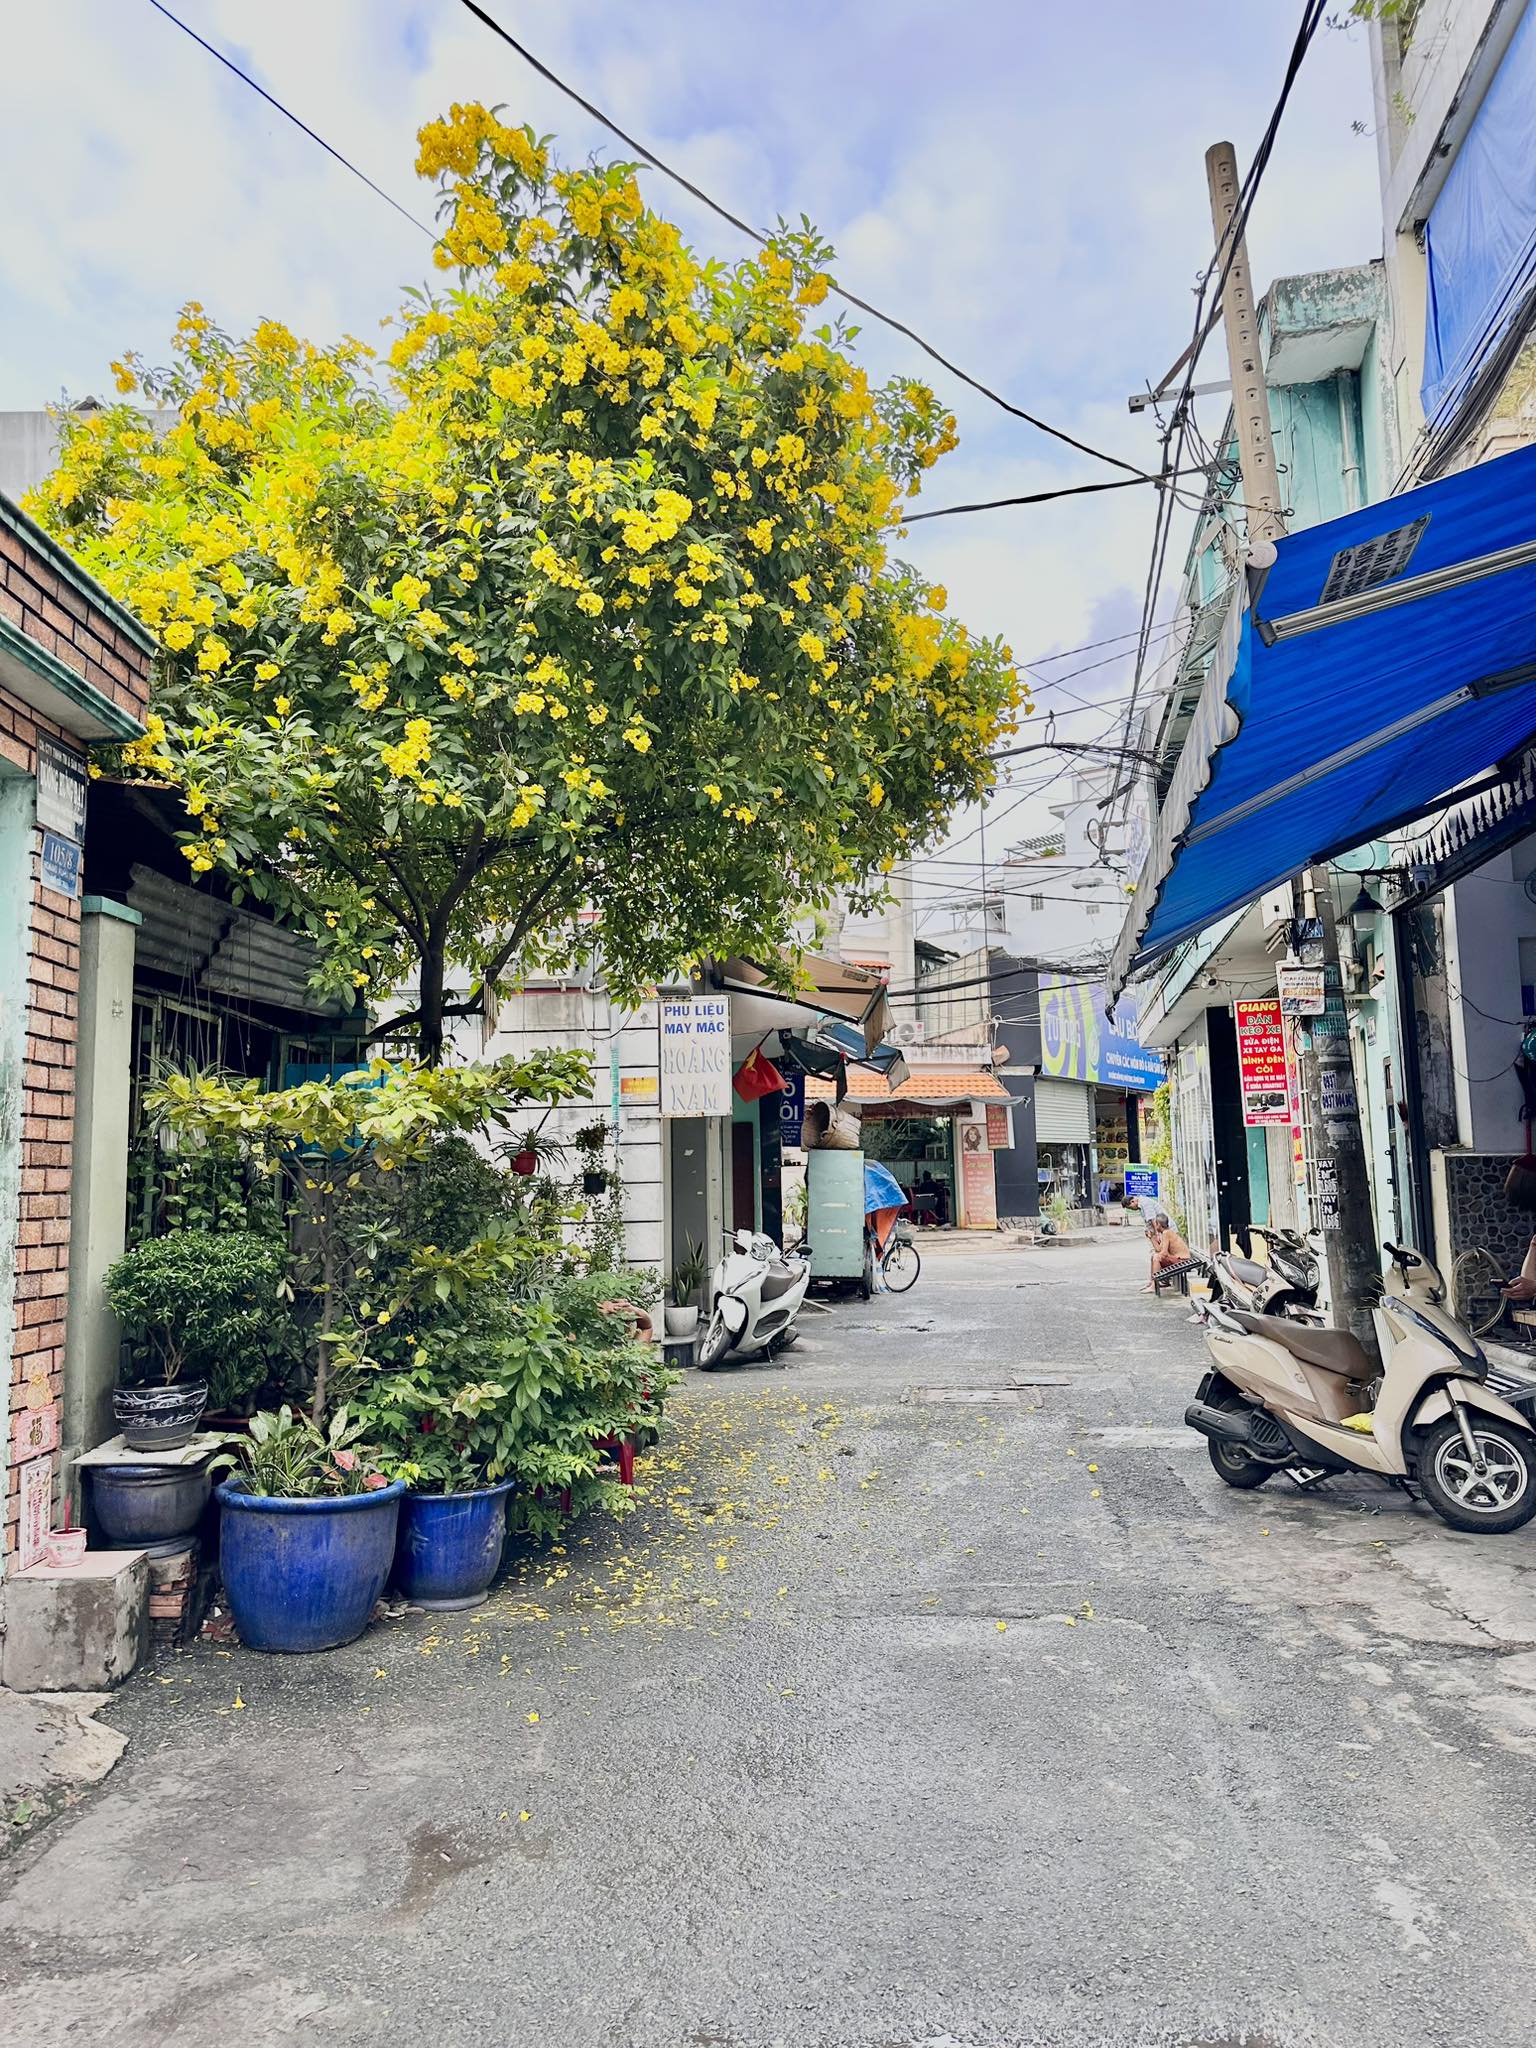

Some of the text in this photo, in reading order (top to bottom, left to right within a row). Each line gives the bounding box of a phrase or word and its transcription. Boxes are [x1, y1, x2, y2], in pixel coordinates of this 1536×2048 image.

[664, 1003, 724, 1019] PHỤ LIỆU
[1239, 1002, 1278, 1013] GIANG
[664, 1023, 692, 1034] MAY
[1266, 1025, 1281, 1035] XE
[1262, 1036, 1280, 1046] ĐIỆN
[663, 1040, 725, 1074] HOÀNG
[1242, 1054, 1285, 1065] BÌNH ĐÈN
[1255, 1064, 1273, 1074] CÒI
[671, 1084, 719, 1111] NAM
